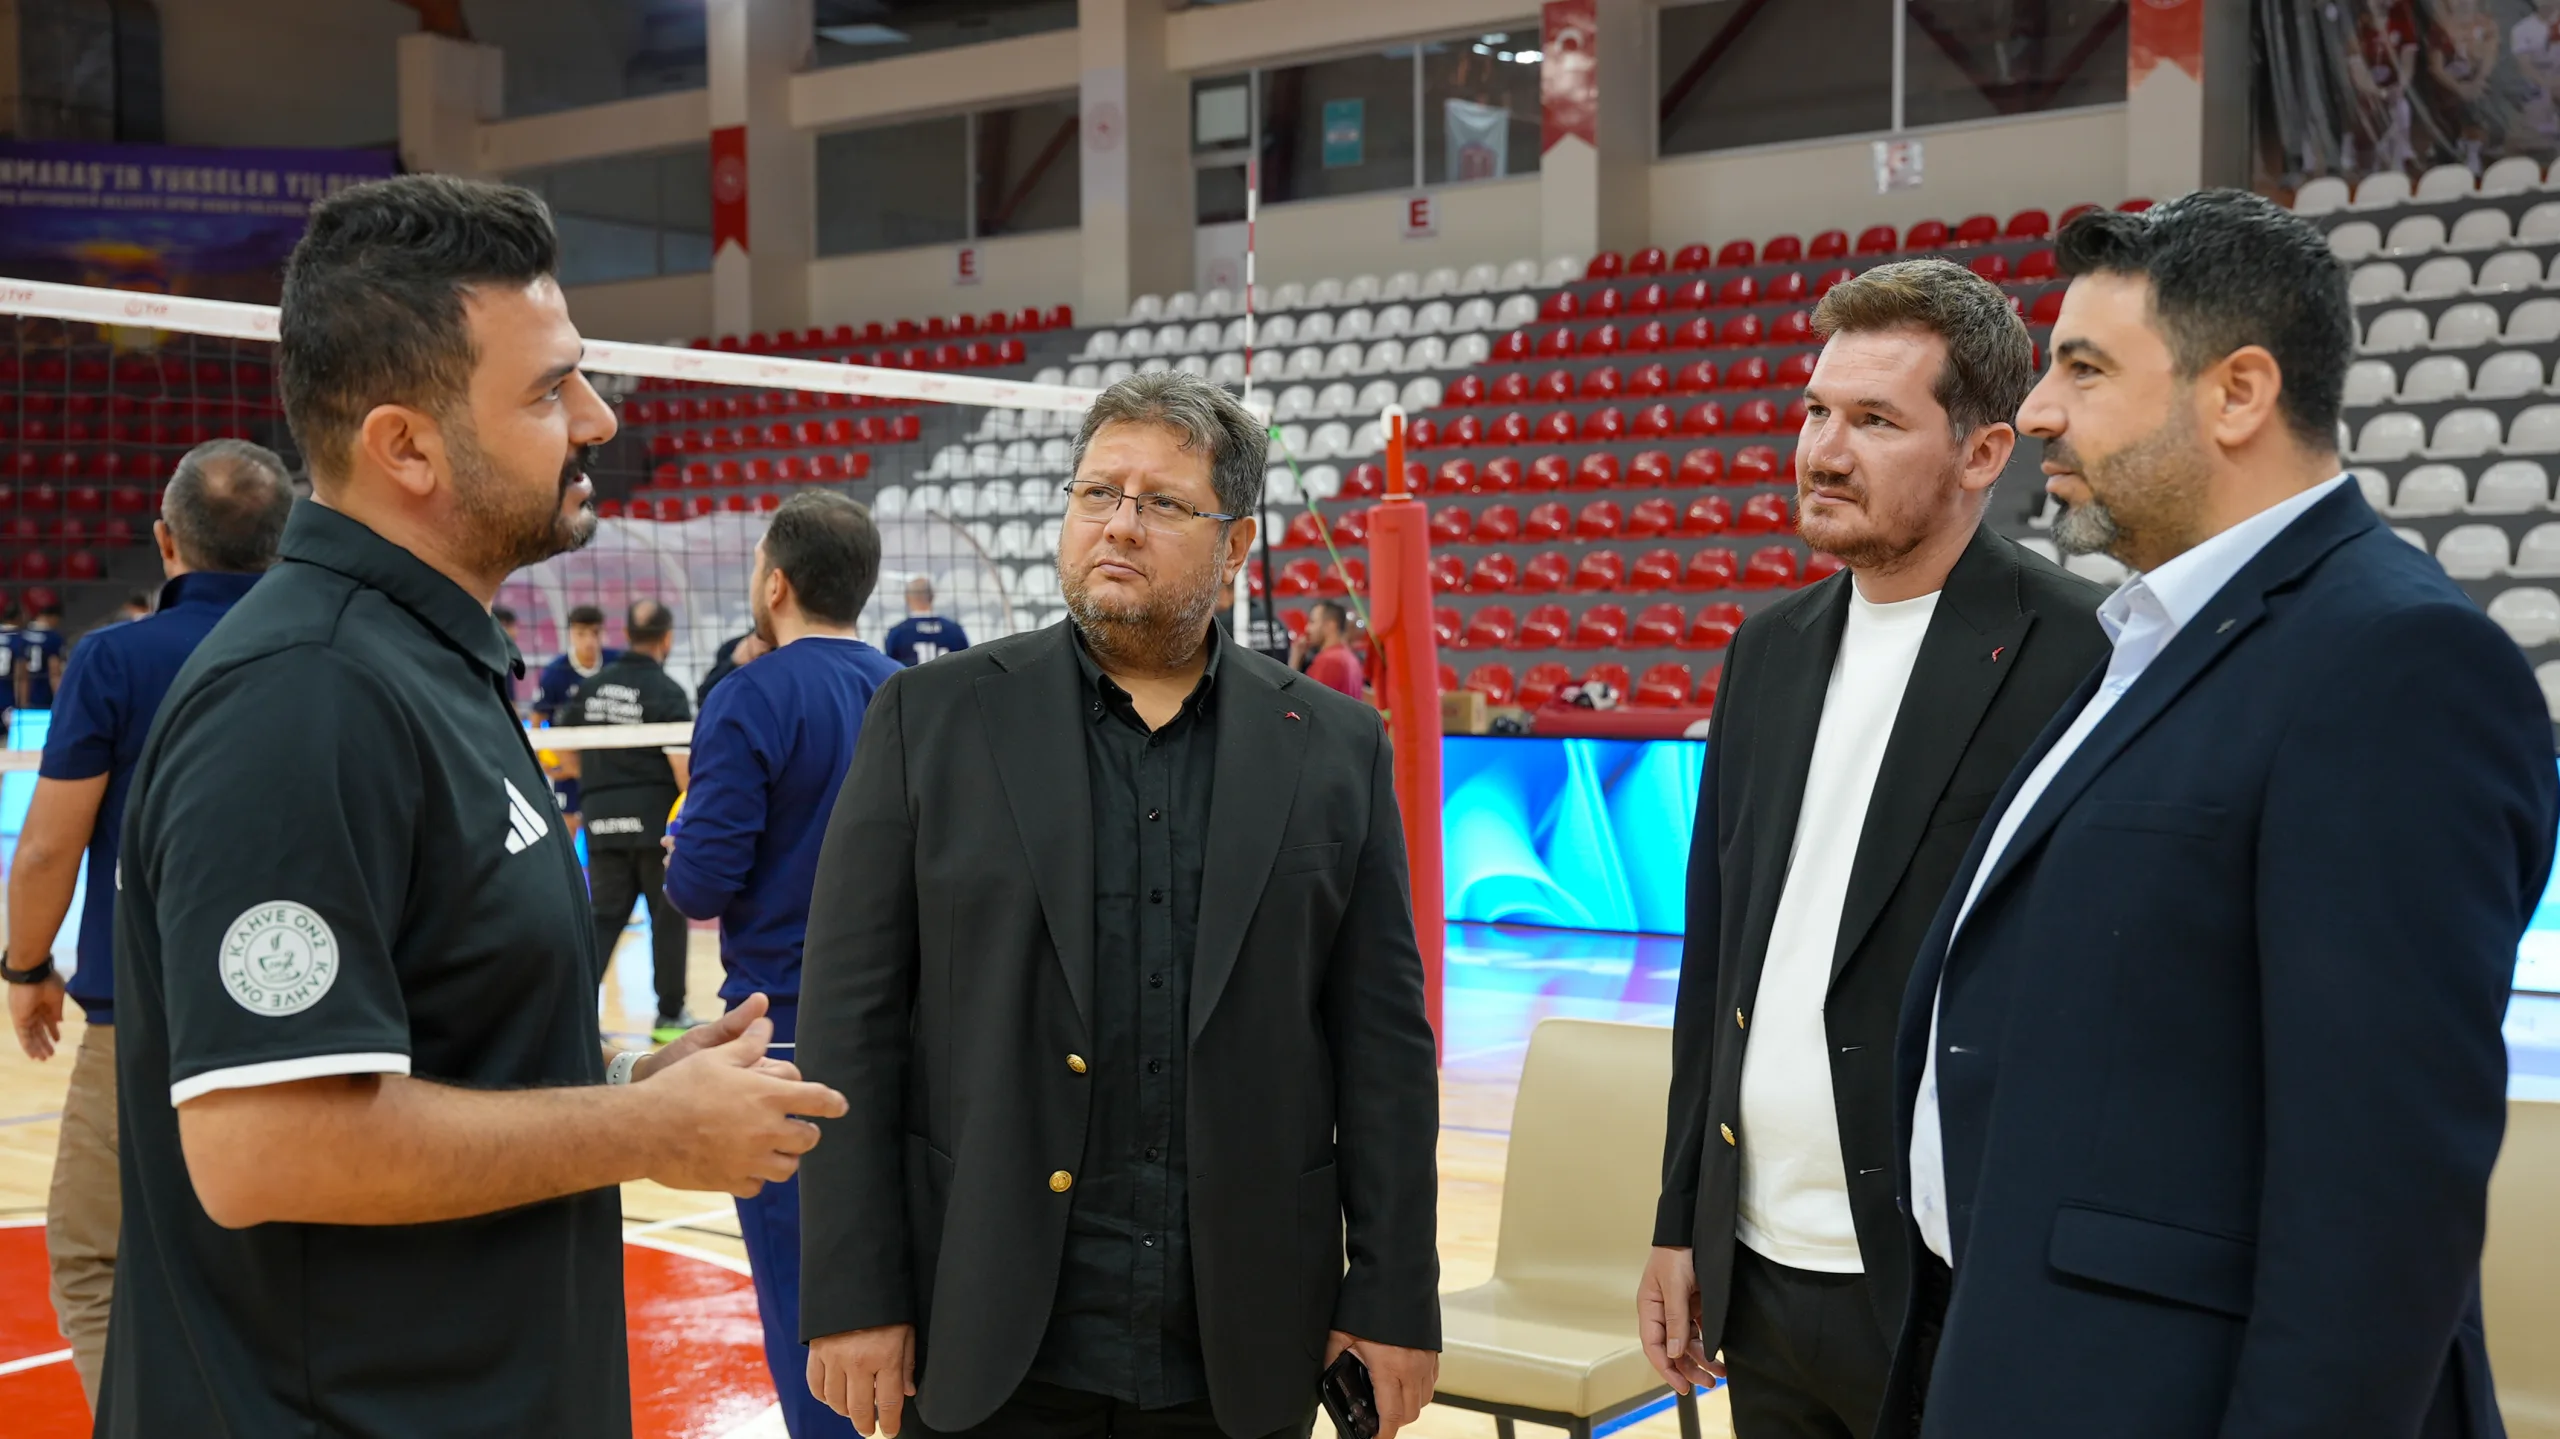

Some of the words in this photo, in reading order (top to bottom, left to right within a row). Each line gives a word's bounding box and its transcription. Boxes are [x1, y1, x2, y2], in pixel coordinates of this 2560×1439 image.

[1409, 199, 1428, 227] E
[959, 249, 975, 276] E
[229, 909, 285, 956] KAHVE
[295, 914, 327, 949] ON2
[231, 969, 262, 1003] ON2
[271, 961, 328, 1007] KAHVE
